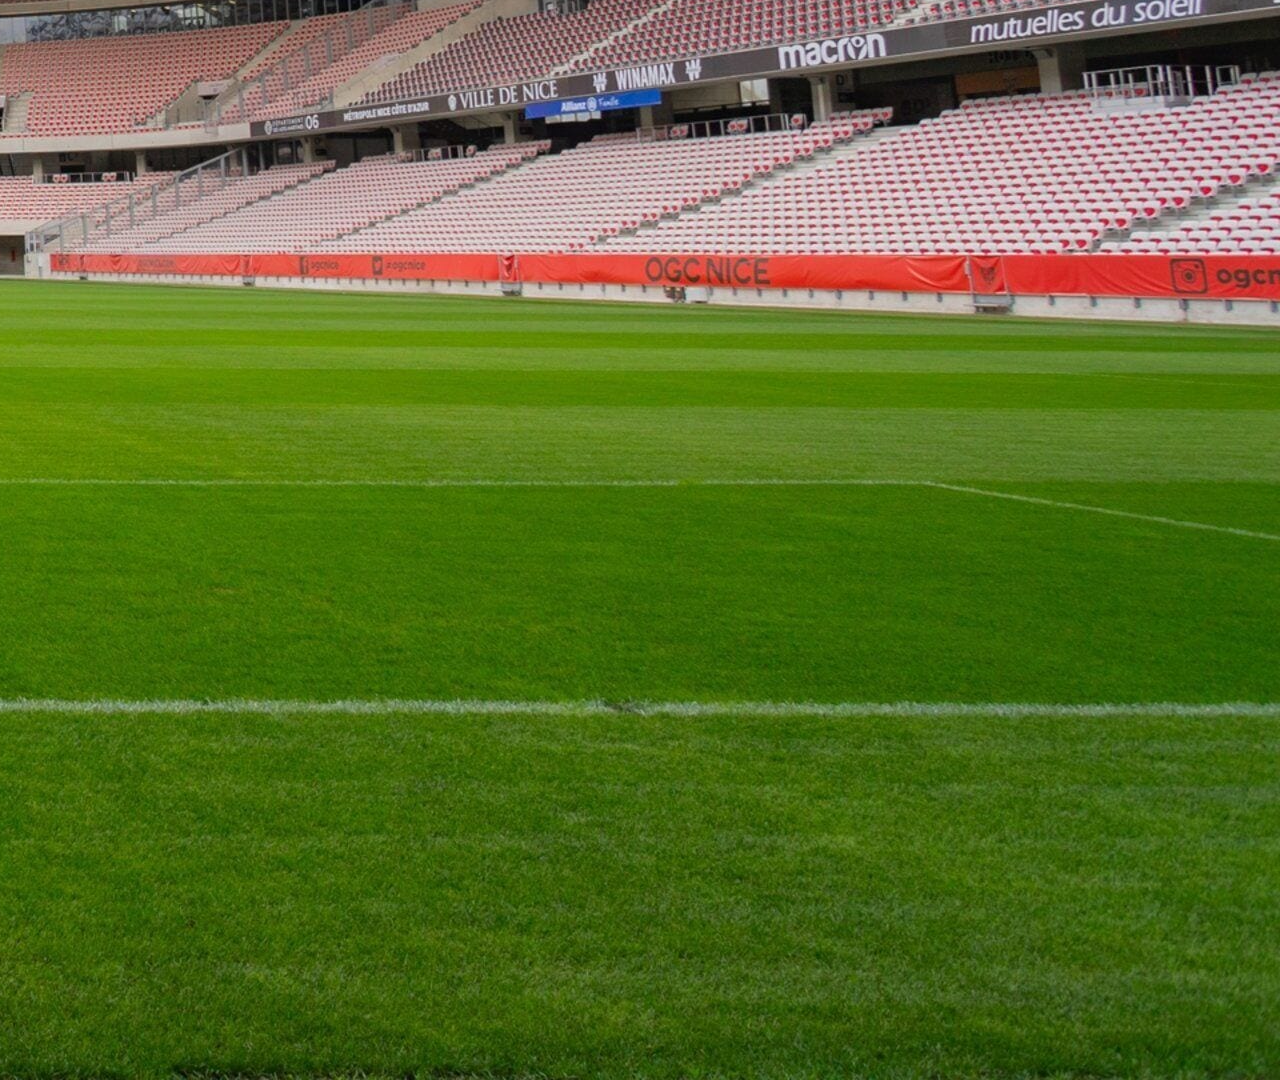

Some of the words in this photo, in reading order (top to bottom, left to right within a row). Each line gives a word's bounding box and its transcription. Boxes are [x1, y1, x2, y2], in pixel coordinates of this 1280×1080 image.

[970, 8, 1085, 44] mutuelles
[1091, 2, 1131, 28] du
[778, 33, 887, 70] macron
[615, 63, 676, 90] WINAMAX
[460, 90, 494, 109] VILLE
[499, 87, 518, 104] DE
[523, 80, 559, 102] NICE
[561, 101, 586, 112] Allianz
[305, 114, 320, 130] 06
[343, 109, 377, 122] MÉTROPOLE
[377, 106, 391, 117] NICE
[407, 101, 430, 113] D'AZUR
[645, 256, 701, 283] OGC
[706, 257, 771, 285] NICE
